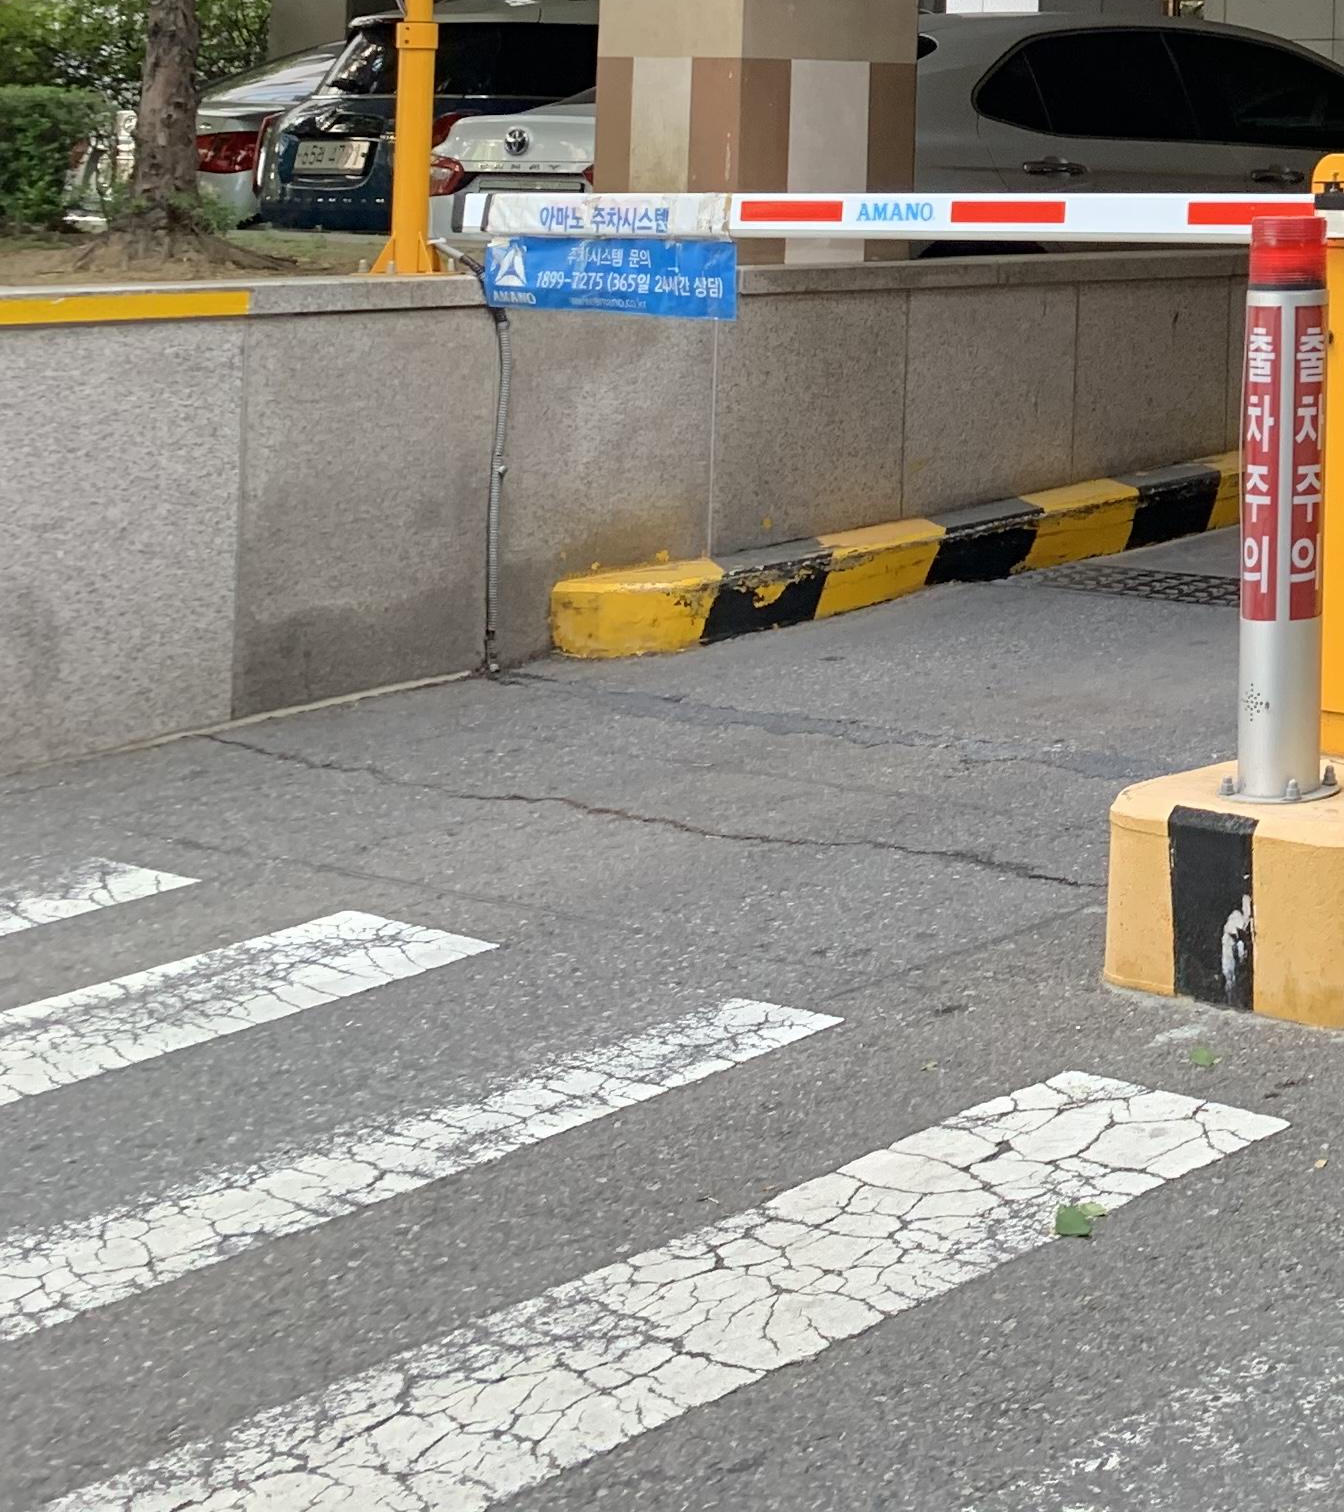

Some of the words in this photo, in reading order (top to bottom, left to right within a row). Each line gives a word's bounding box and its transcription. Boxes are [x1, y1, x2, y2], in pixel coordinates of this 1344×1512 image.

[540, 206, 584, 232] 아마노
[590, 206, 669, 234] 주차시스템
[856, 201, 935, 223] AMANO
[567, 246, 624, 268] 주차시스템
[628, 249, 651, 269] 문의
[535, 271, 603, 292] 1899-7275
[607, 272, 651, 294] (365일
[694, 276, 723, 299] 상담)
[493, 290, 537, 305] AMANO
